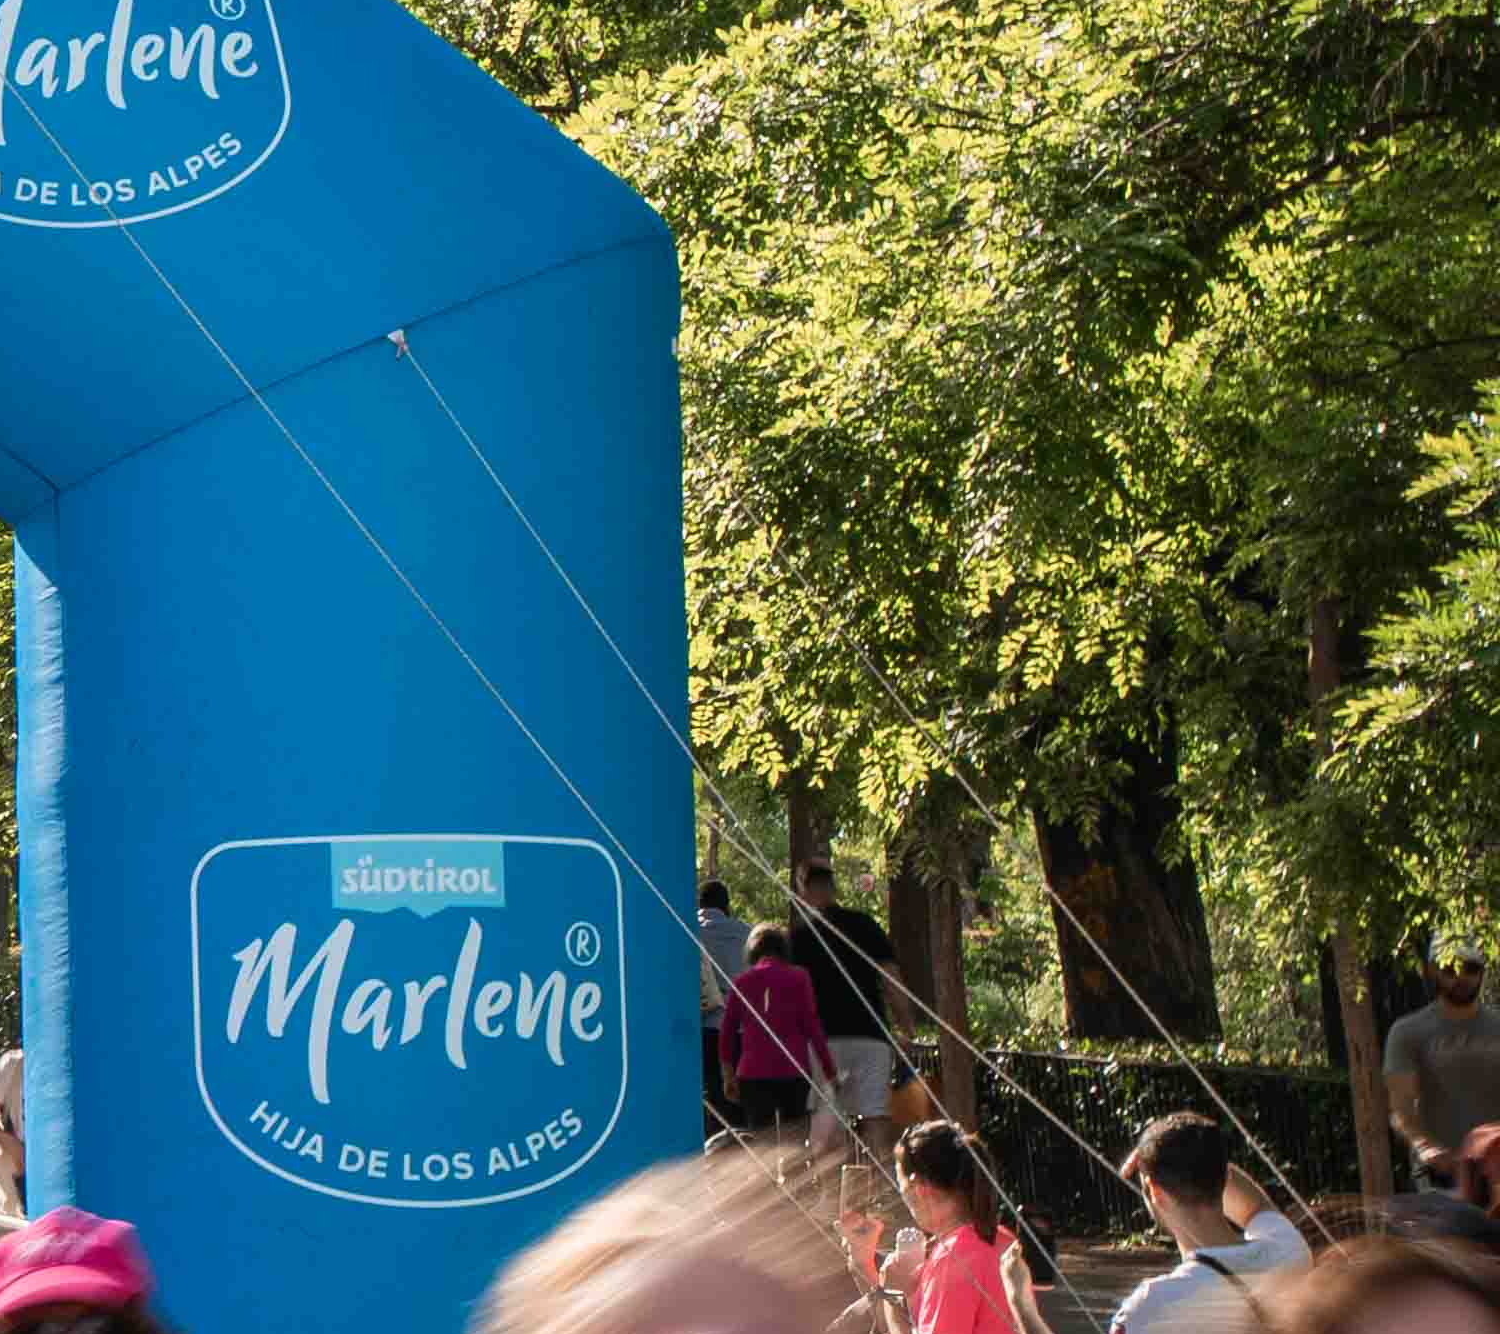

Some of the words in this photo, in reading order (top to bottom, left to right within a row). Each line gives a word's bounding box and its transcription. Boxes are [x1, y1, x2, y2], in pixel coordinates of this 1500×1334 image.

[15, 178, 59, 205] DE
[70, 178, 136, 207] LOS
[148, 131, 242, 196] ALPES
[249, 1101, 324, 1163] HIJA
[338, 1144, 389, 1178] DE
[402, 1153, 475, 1181] LOS
[487, 1108, 583, 1176] ALPES
